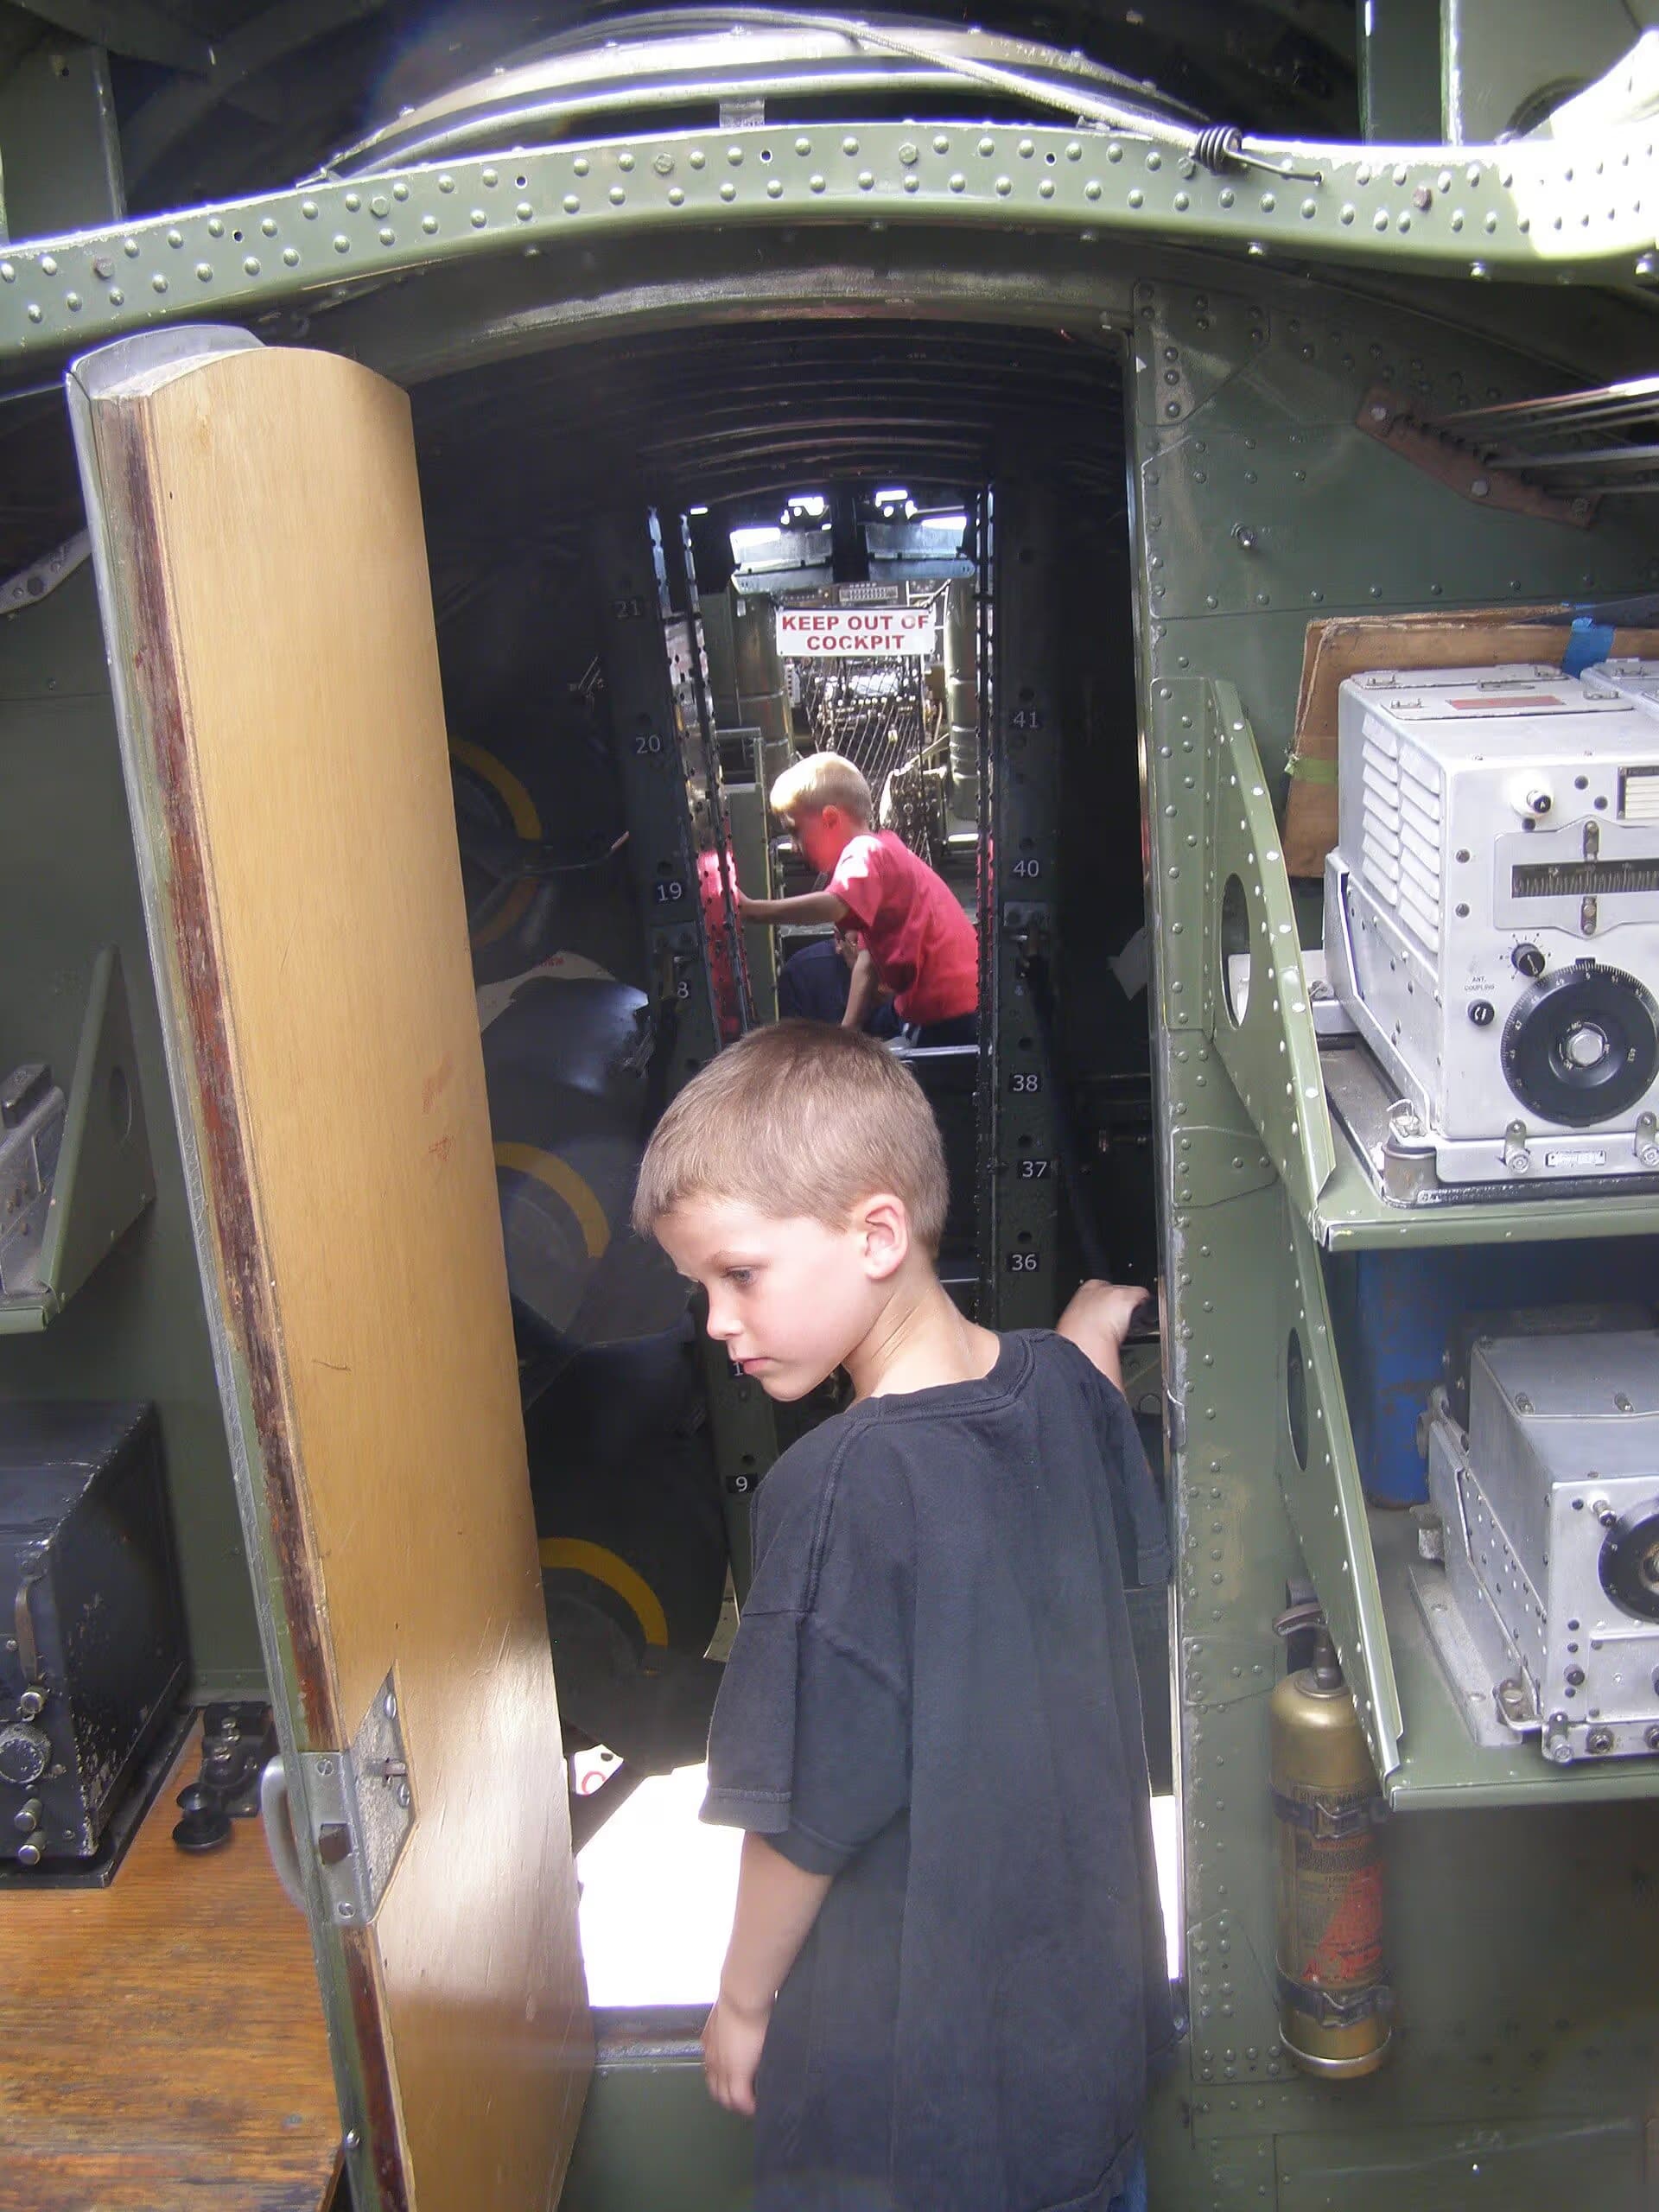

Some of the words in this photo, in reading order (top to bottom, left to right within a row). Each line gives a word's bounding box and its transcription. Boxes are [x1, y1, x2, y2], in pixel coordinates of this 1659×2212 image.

[782, 615, 839, 631] KEEP
[848, 615, 893, 630] OUT
[901, 614, 929, 630] OF
[807, 635, 905, 651] COCKPIT
[1013, 710, 1038, 728] 41
[635, 734, 661, 754] 20
[1013, 860, 1039, 878] 40
[657, 880, 683, 901] 19
[677, 981, 690, 1000] 8
[1012, 1074, 1039, 1092] 38
[1021, 1160, 1047, 1178] 37
[1011, 1253, 1038, 1271] 36
[735, 1476, 748, 1493] 9
